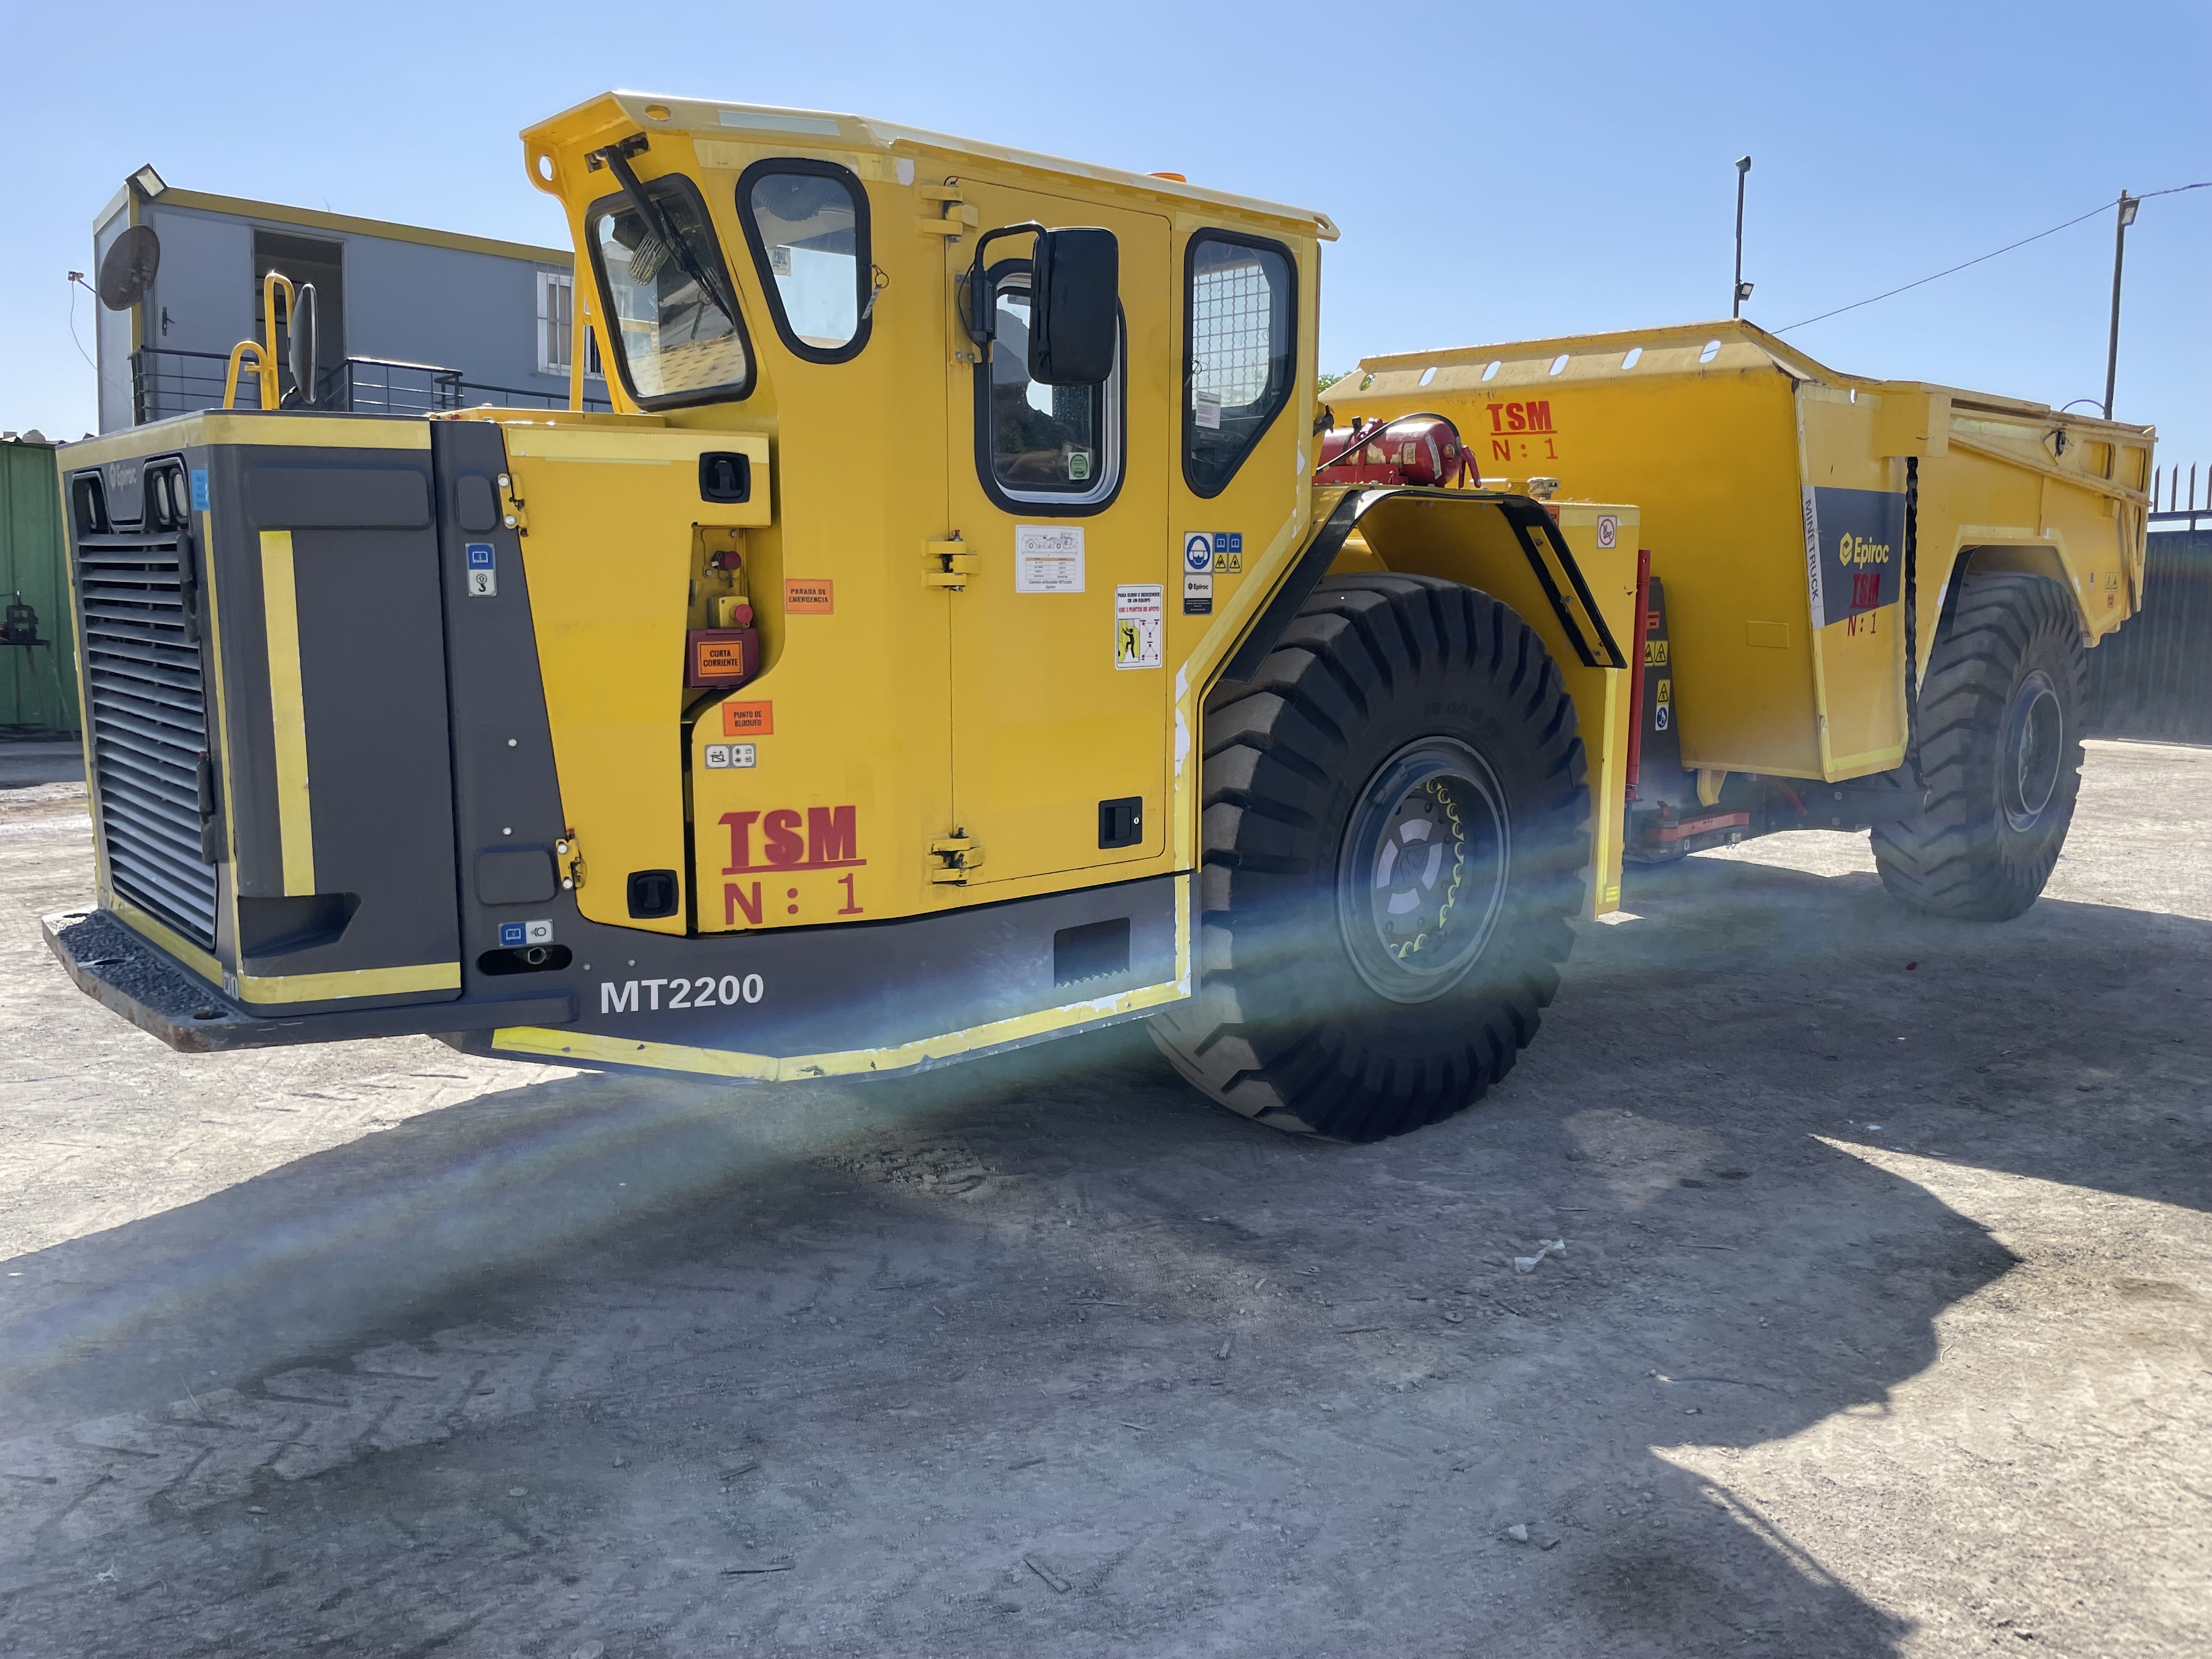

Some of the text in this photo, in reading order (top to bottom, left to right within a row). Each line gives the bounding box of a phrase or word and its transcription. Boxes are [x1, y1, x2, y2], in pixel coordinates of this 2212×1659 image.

[1486, 401, 1552, 431] TSM
[1544, 437, 1558, 459] 1
[1805, 499, 1819, 602] MINETRUCK
[1853, 536, 1889, 569] Epiroc
[1853, 573, 1881, 605] TSM
[703, 659, 738, 667] CORRIENTE
[718, 805, 856, 867] TSM
[838, 873, 864, 915] 1
[601, 973, 764, 1014] MT2200
